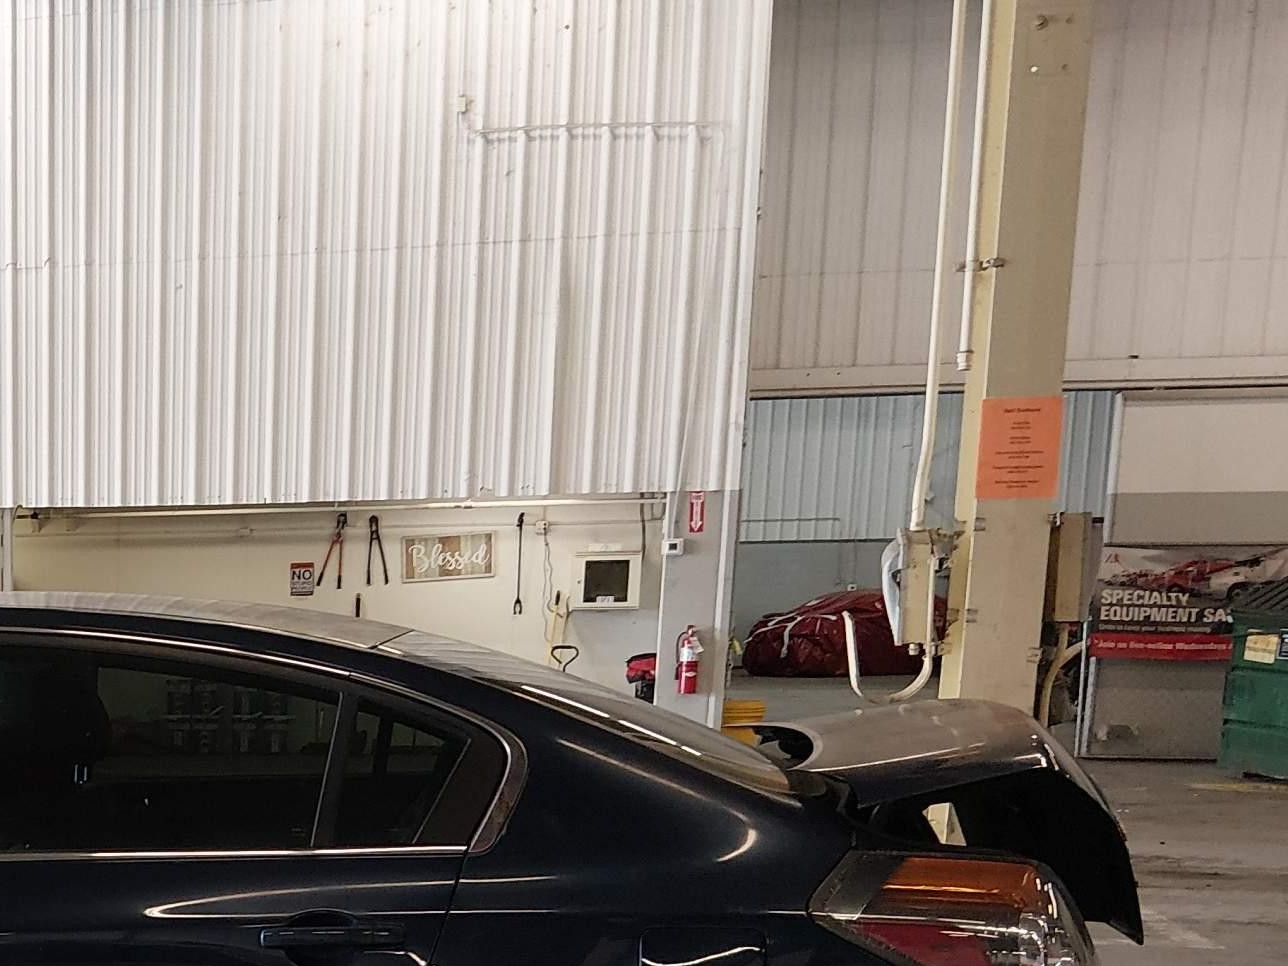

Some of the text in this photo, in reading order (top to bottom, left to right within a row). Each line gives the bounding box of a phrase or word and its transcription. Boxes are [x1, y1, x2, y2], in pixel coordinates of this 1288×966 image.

[408, 543, 490, 573] Blessed
[292, 569, 312, 580] NO
[1100, 588, 1190, 606] SPECIALTY
[1099, 605, 1201, 622] EQUIPMENT
